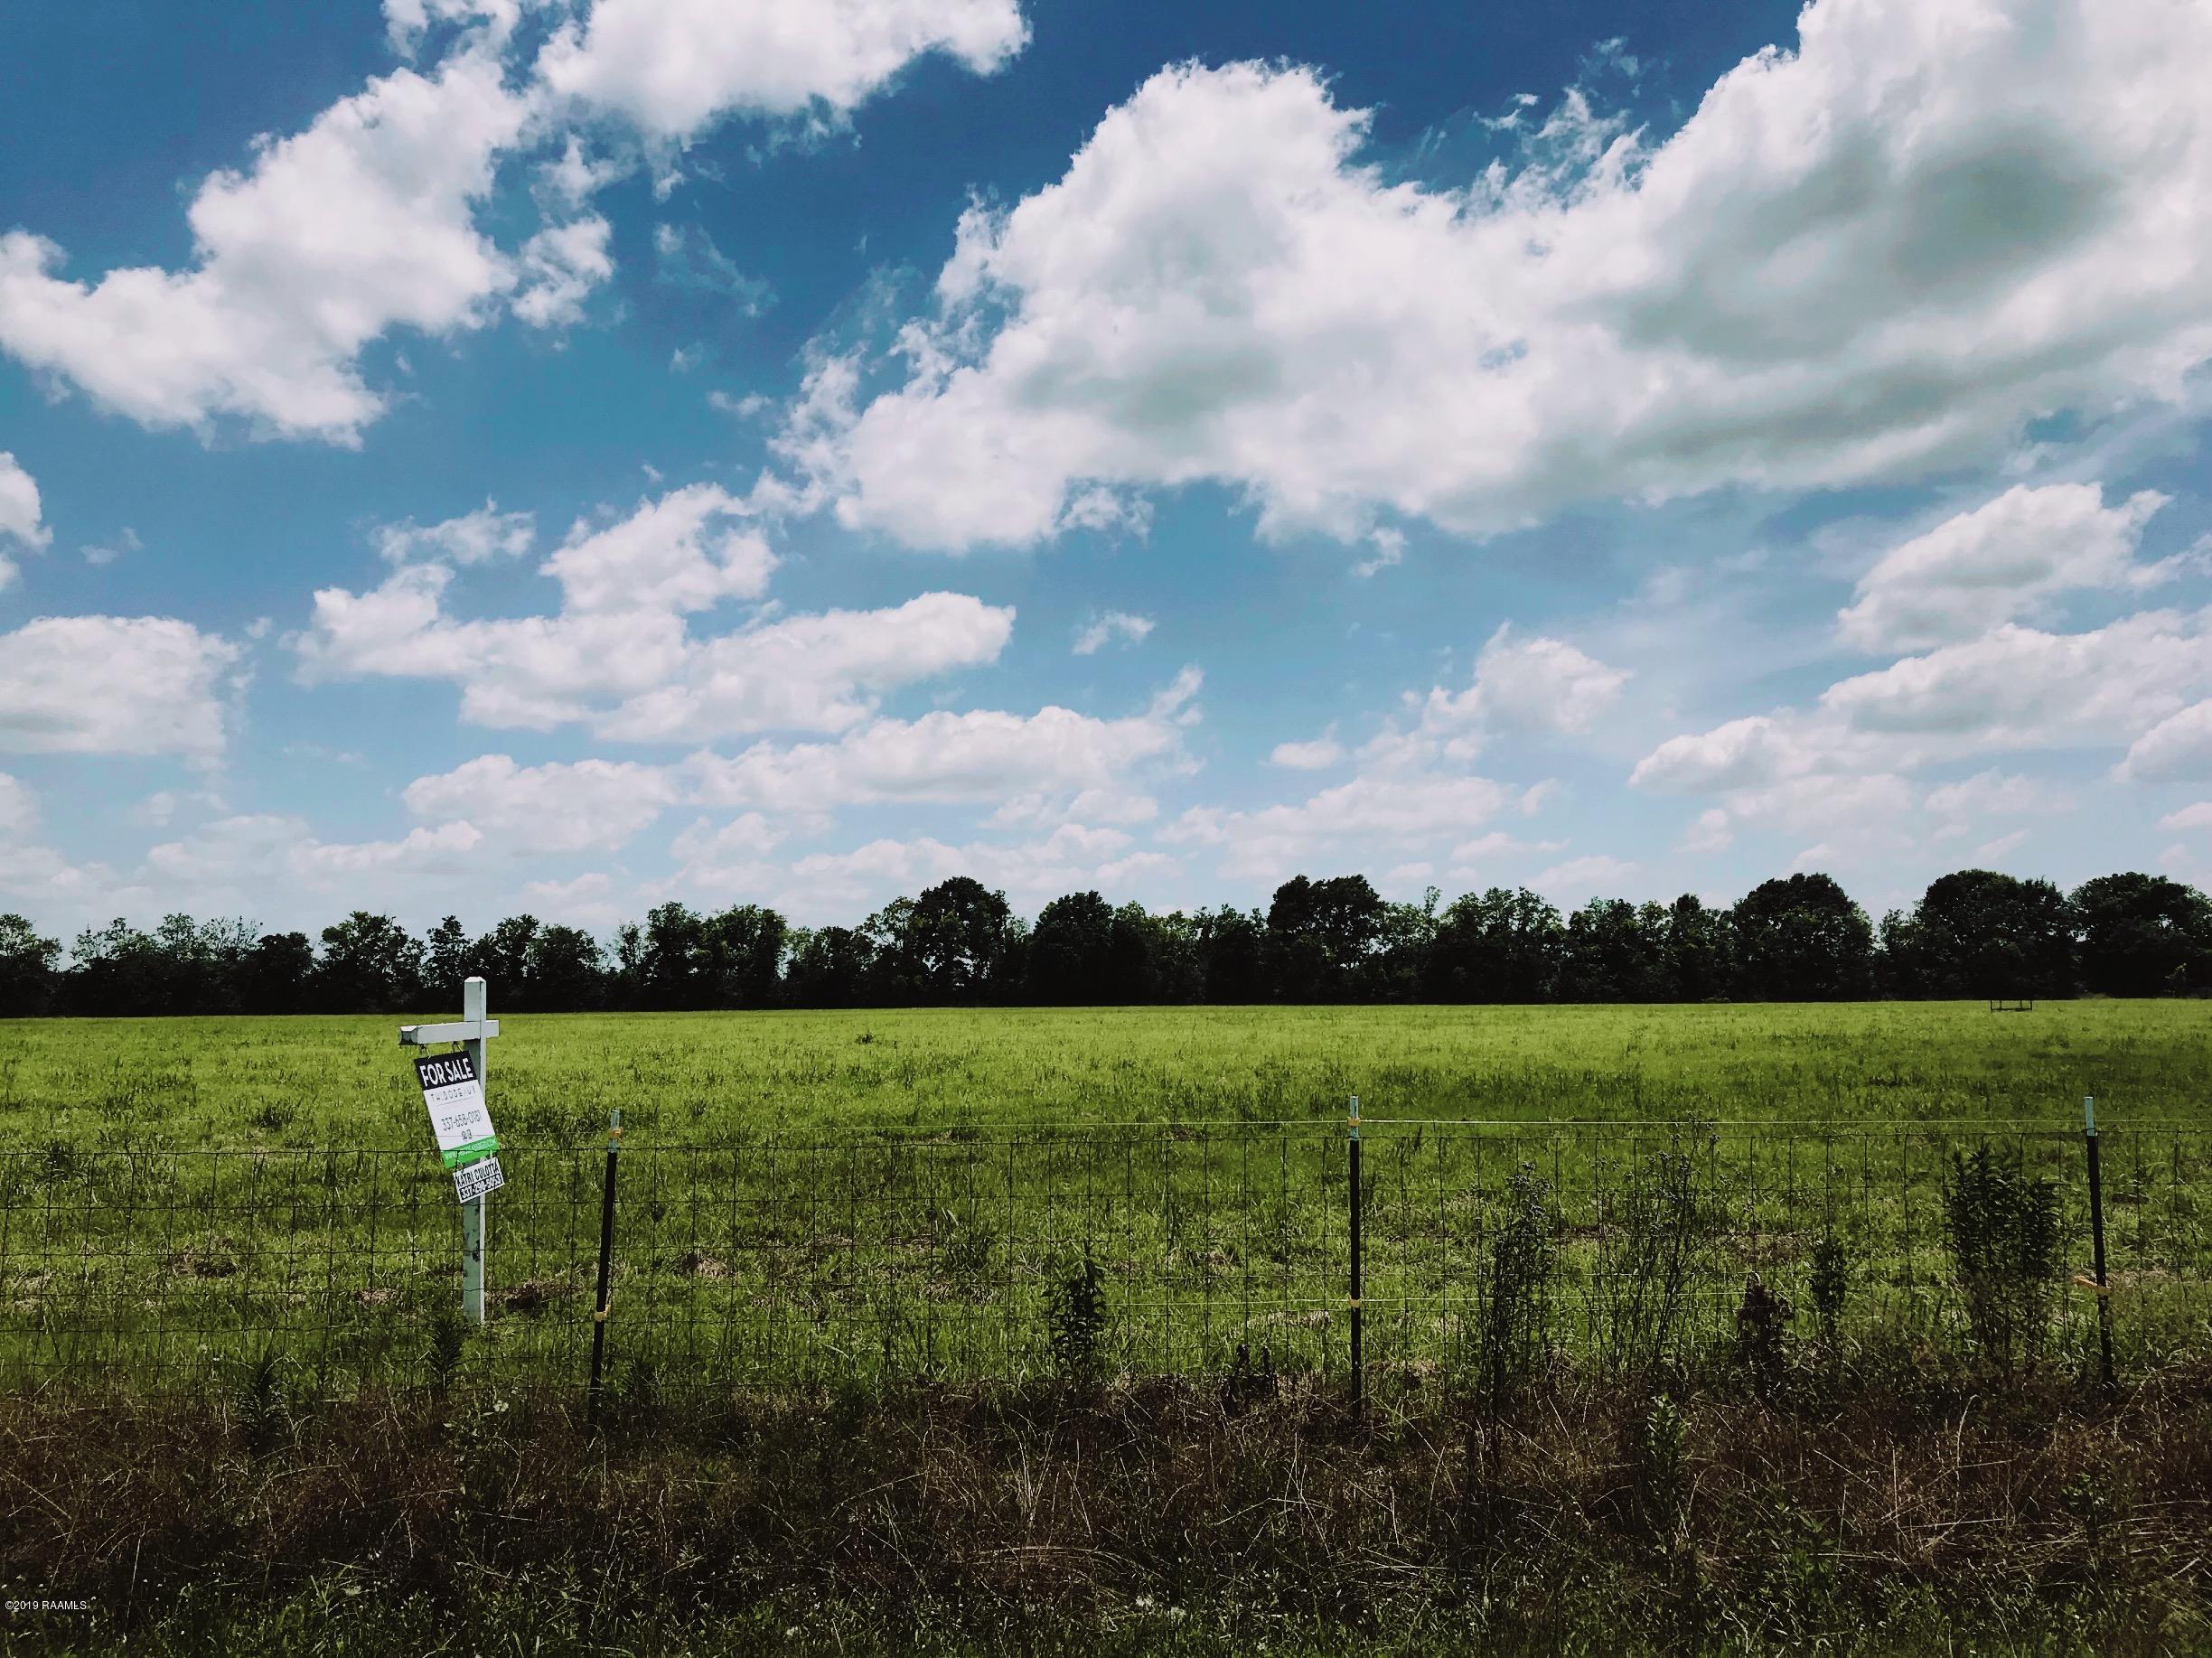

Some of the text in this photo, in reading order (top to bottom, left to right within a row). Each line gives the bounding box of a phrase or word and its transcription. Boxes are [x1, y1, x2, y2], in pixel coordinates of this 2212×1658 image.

[419, 1057, 474, 1087] FOR SALE
[455, 1163, 500, 1187] KATRI CULOTTA
